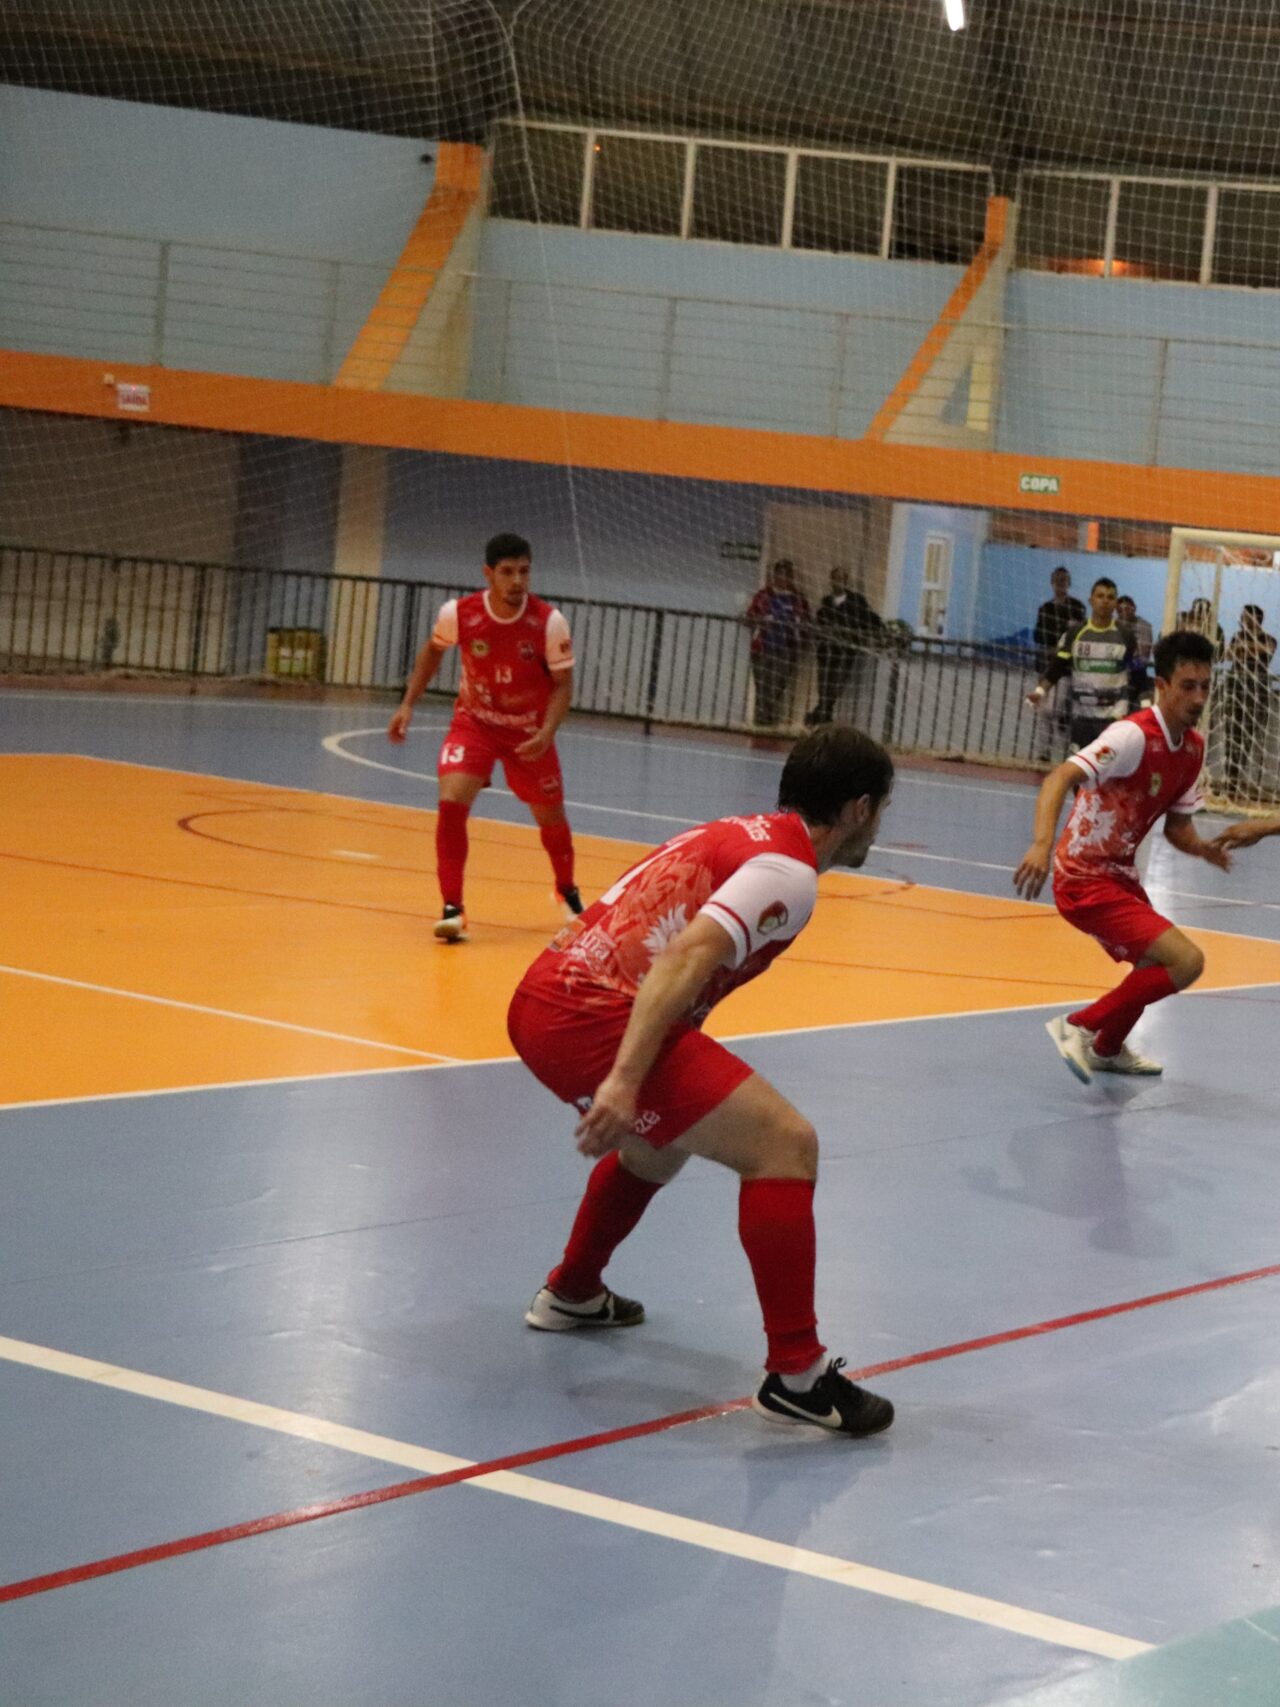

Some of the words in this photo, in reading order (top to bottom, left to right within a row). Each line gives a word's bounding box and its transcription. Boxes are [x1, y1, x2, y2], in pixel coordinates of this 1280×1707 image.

[1021, 476, 1058, 493] COPA
[496, 665, 513, 685] 13
[441, 743, 465, 766] 13
